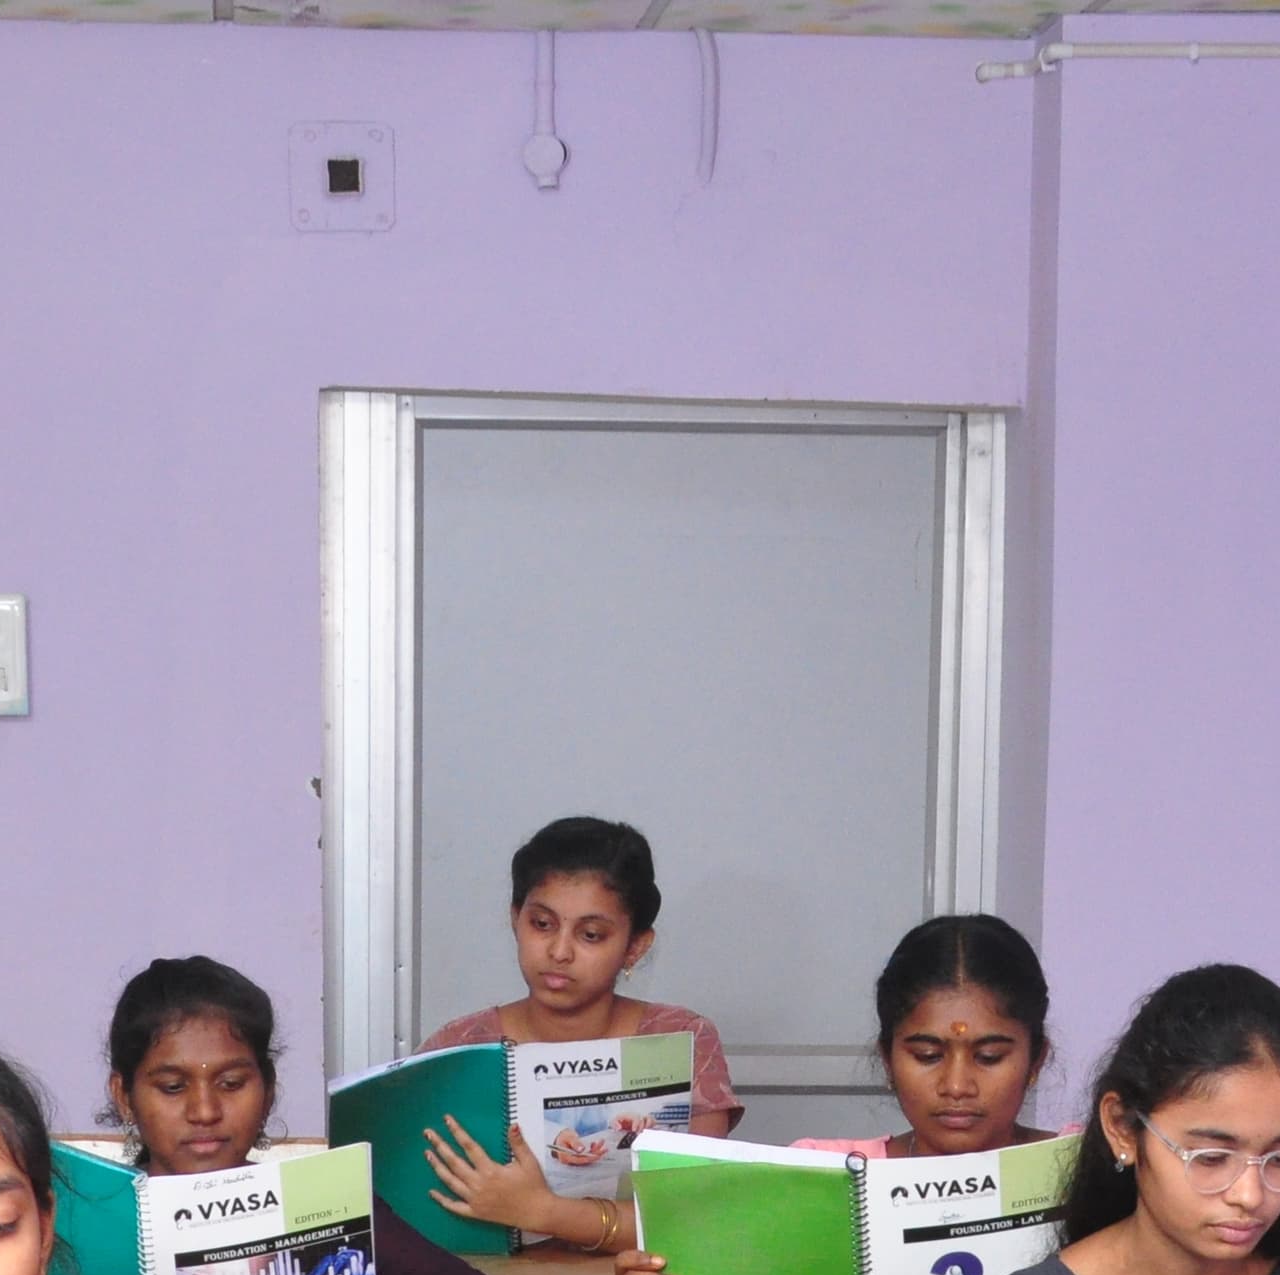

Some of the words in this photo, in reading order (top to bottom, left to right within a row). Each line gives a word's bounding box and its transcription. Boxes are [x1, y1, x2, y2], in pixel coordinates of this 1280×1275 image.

[553, 1057, 619, 1075] VYASA
[914, 1174, 997, 1200] VYASA
[197, 1189, 279, 1220] VYASA
[1012, 1195, 1050, 1209] EDITION
[294, 1209, 333, 1225] EDITION
[949, 1219, 1014, 1236] FOUNDATION
[1021, 1212, 1045, 1225] LAW
[203, 1243, 267, 1262] FOUNDATION
[275, 1225, 345, 1249] MANAGEMENT
